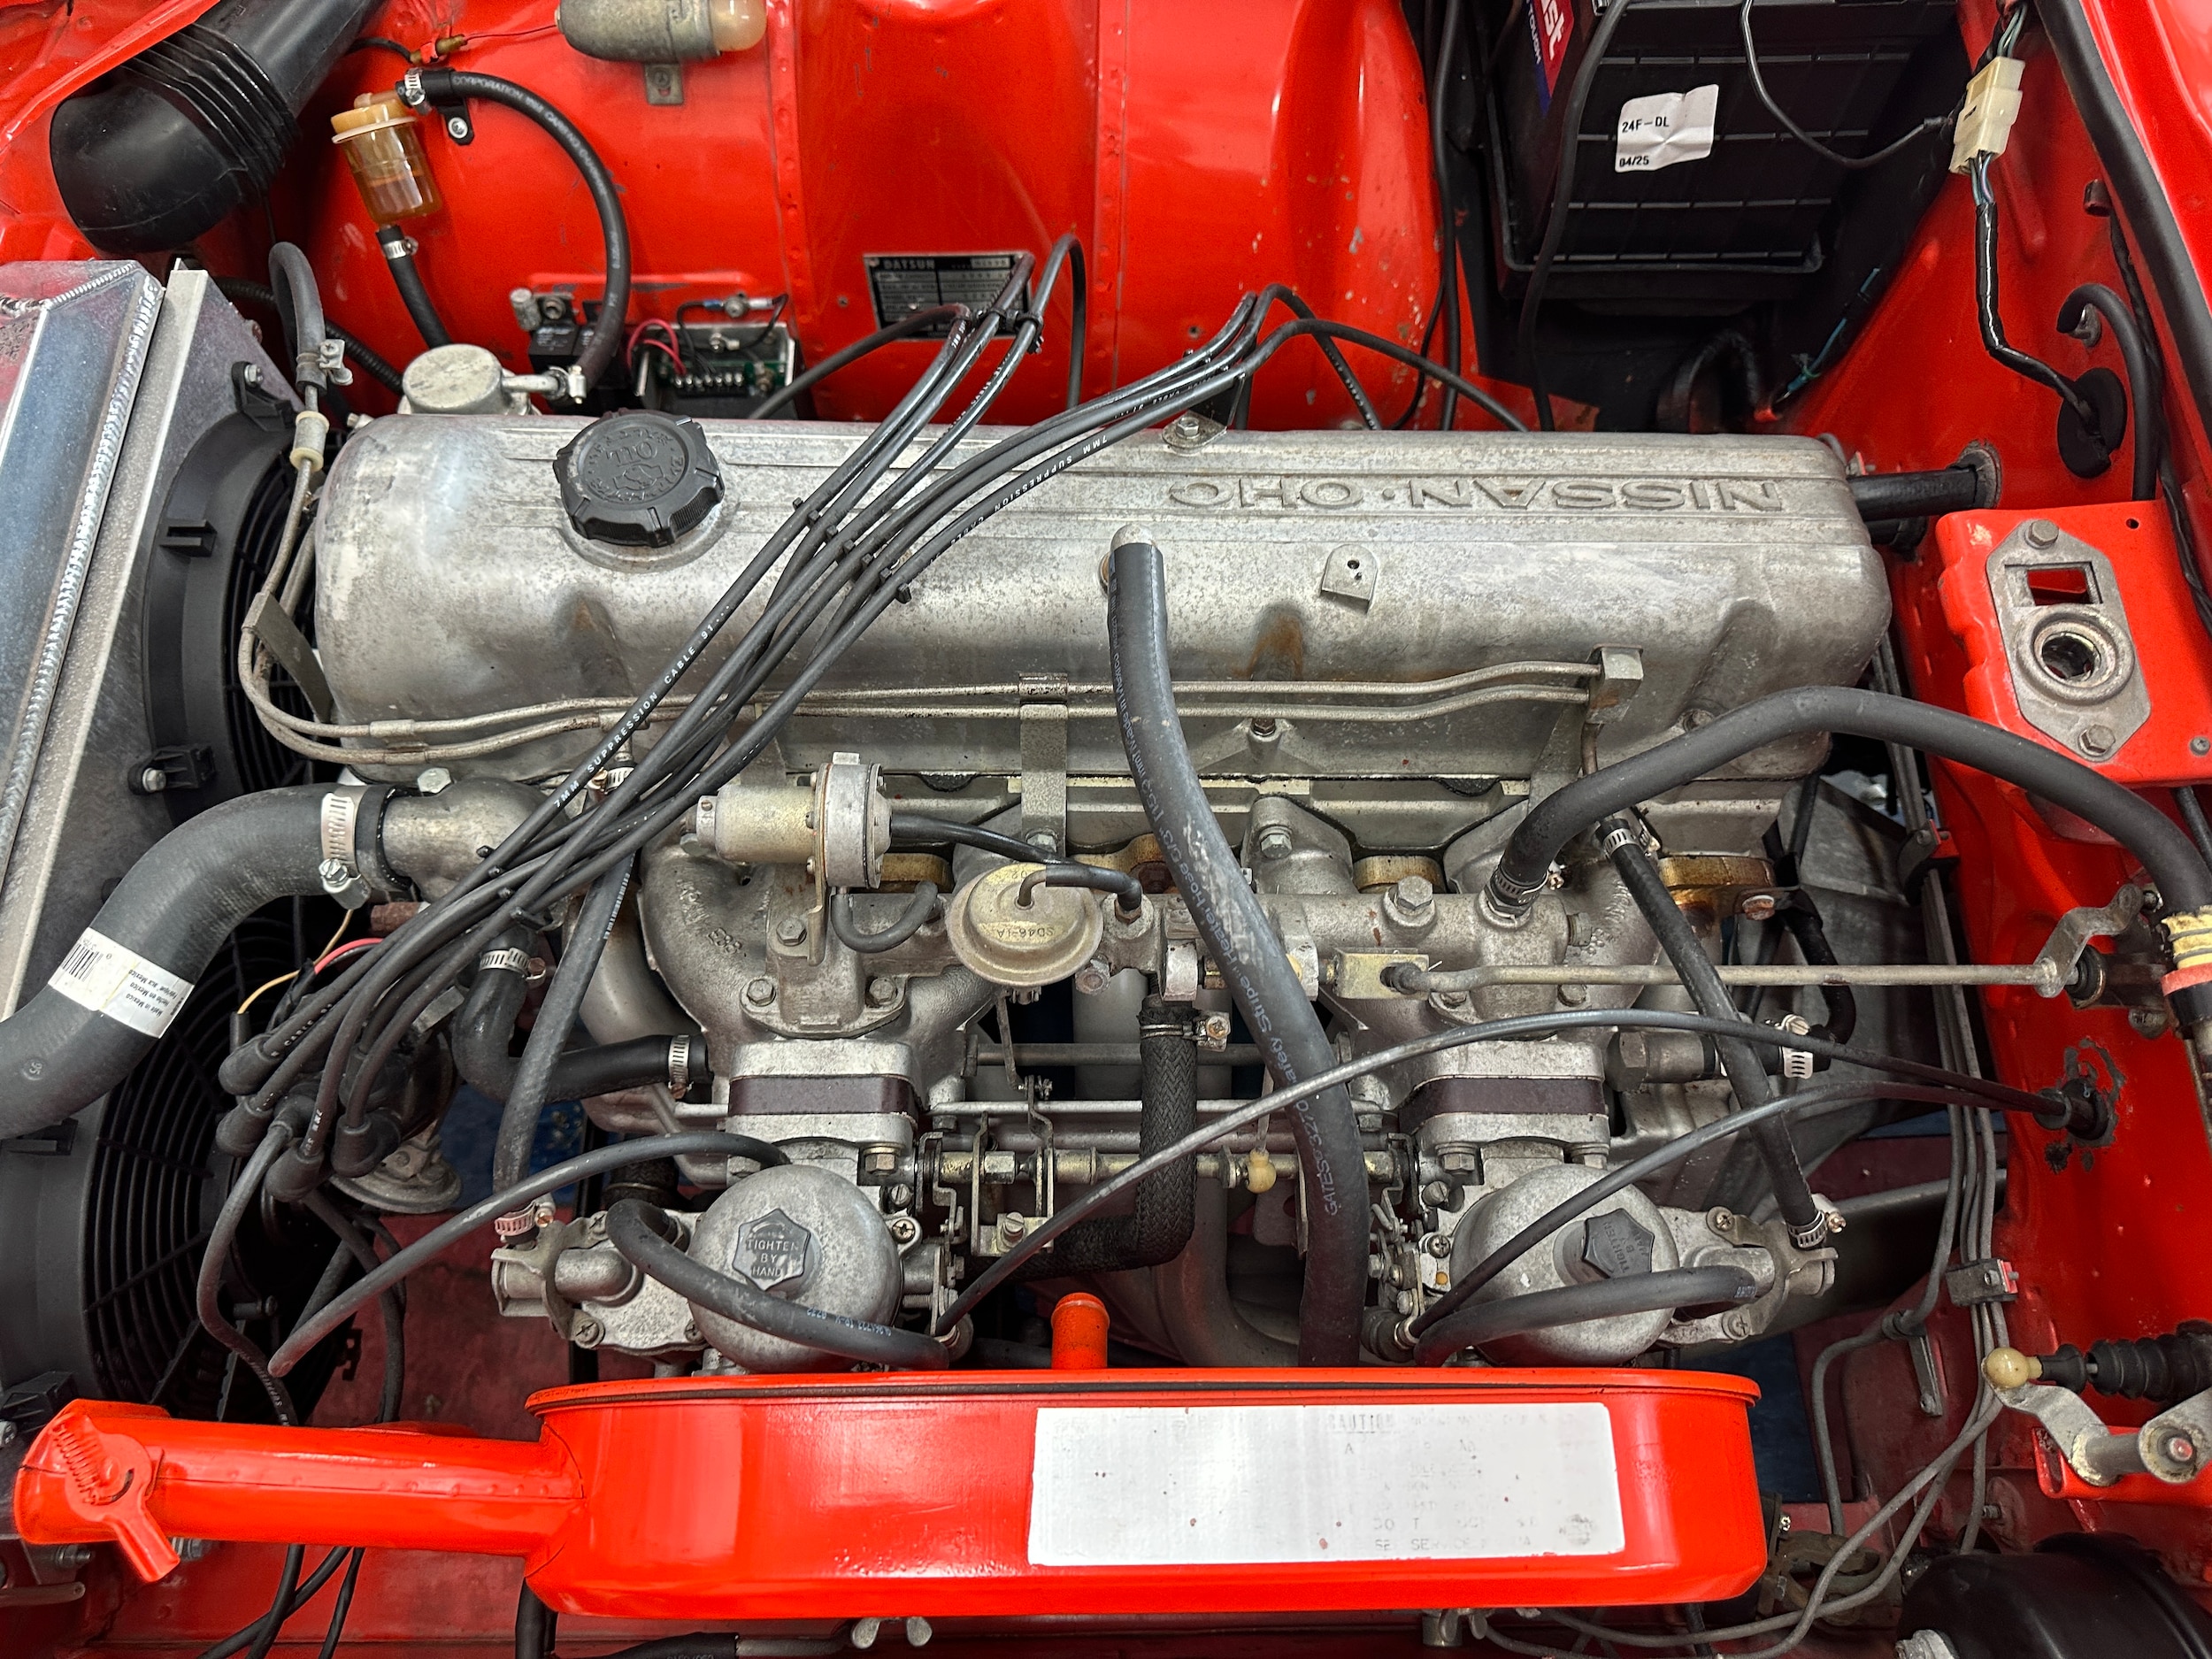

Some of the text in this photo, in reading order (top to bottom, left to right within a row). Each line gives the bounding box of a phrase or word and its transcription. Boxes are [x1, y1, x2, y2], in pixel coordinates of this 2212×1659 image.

[1619, 156, 1649, 167] 04/25
[885, 259, 935, 270] DATSUN
[1082, 434, 1109, 455] 7MM
[606, 442, 658, 465] OIL
[994, 455, 1073, 513] SUPPRESSION
[554, 780, 580, 808] 7MM
[587, 691, 658, 773] SUPPRESSION
[664, 646, 695, 685] CABLE
[128, 969, 150, 984] Mexico
[130, 982, 149, 997] Mexico
[126, 993, 145, 1009] Mexico
[1270, 1036, 1297, 1084] afety
[747, 1239, 800, 1252] TIGHTEN
[1602, 1222, 1630, 1273] TIGHTEN
[760, 1253, 779, 1263] BY
[752, 1266, 782, 1277] HAND
